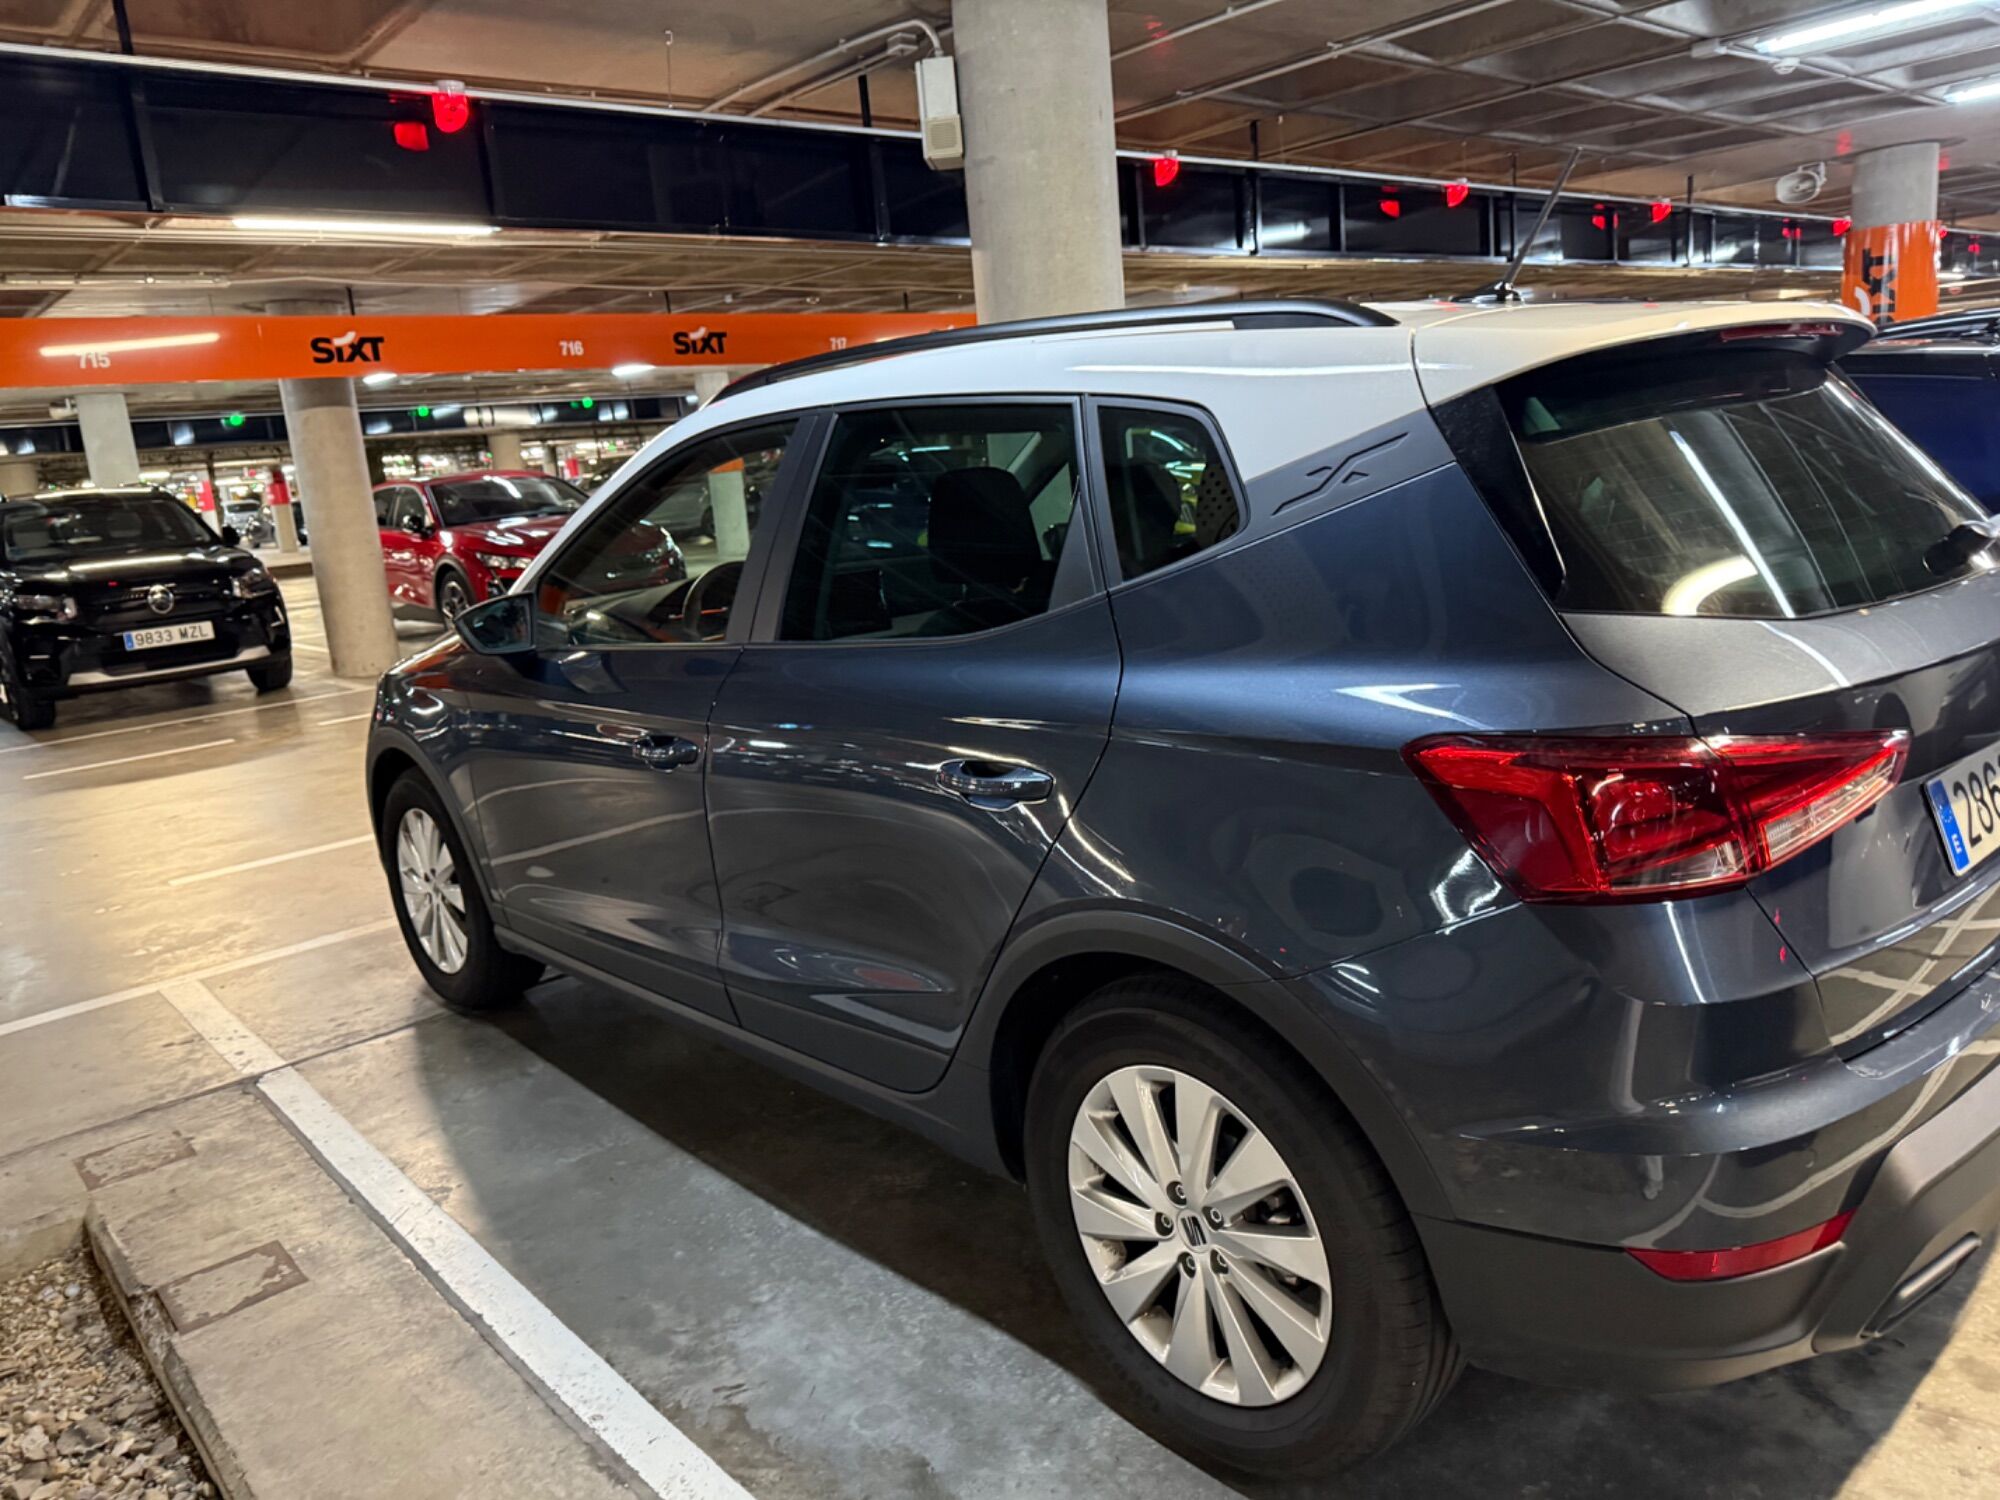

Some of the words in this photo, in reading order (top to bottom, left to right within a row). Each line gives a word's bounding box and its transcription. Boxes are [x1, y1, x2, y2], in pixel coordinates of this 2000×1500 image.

[559, 340, 584, 356] 716
[76, 350, 111, 369] 715
[134, 630, 173, 647] 9833
[178, 625, 209, 641] MZL
[1953, 757, 2000, 848] 286
